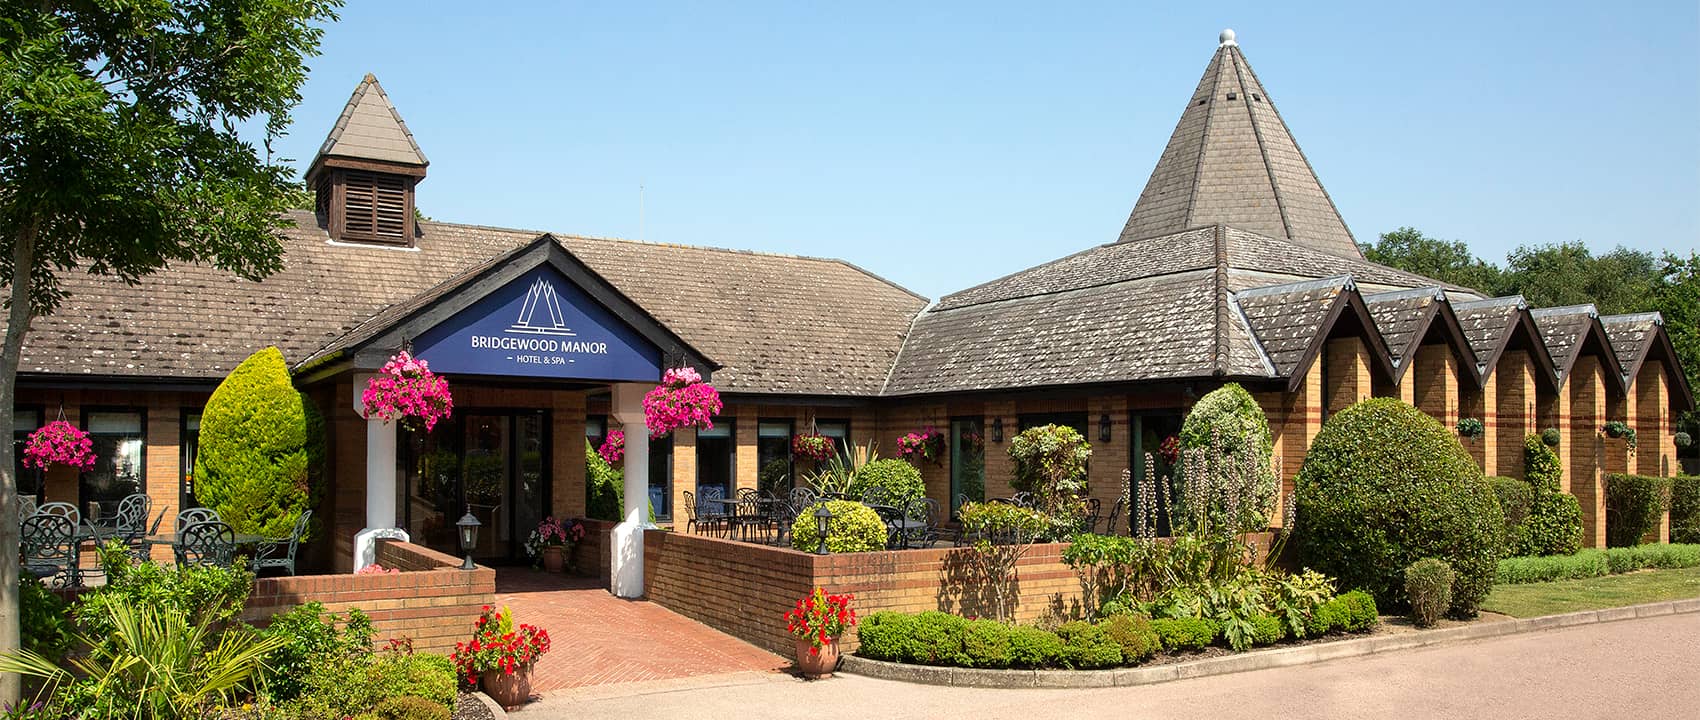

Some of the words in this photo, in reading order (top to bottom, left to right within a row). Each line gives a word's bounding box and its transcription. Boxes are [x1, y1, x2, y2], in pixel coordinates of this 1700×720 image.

[471, 335, 558, 352] BRIDGEWOOD
[561, 341, 608, 354] MANOR
[516, 355, 542, 364] HOTEL
[543, 356, 551, 365] &
[551, 357, 566, 365] SPA
